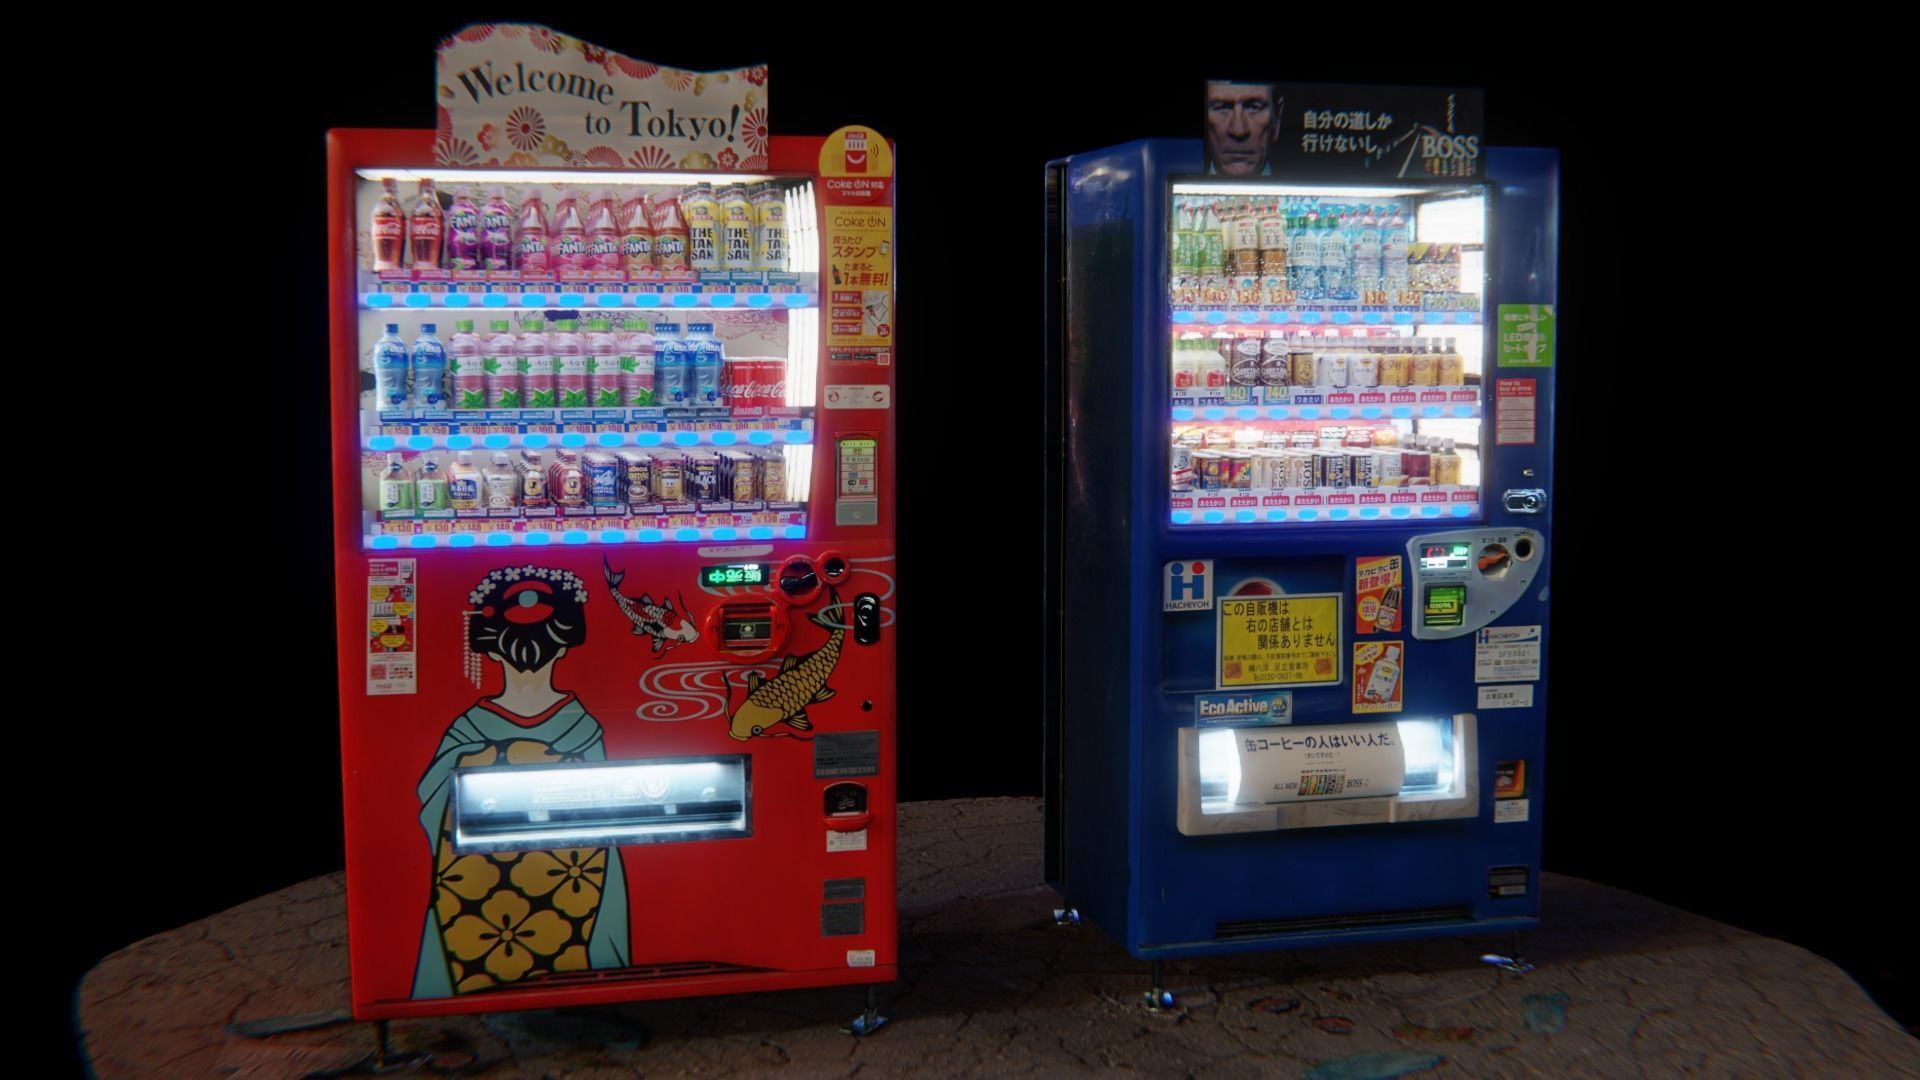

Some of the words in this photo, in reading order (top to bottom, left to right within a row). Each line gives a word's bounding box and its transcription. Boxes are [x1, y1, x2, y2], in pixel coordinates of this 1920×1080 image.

[456, 60, 614, 105] Welcome
[585, 109, 611, 135] to
[619, 100, 740, 143] Tokyo!
[1303, 110, 1392, 130] 自分の道しか
[1421, 135, 1479, 160] BOSS
[827, 179, 852, 189] Coke
[834, 216, 864, 227] Coke
[691, 228, 714, 238] THE
[727, 228, 751, 238] THE
[691, 239, 714, 249] TAN
[727, 239, 751, 249] TAN
[691, 250, 714, 260] SAN
[727, 250, 751, 260] SAN
[832, 246, 878, 258] スタンプ
[1303, 460, 1312, 487] BOS
[1165, 601, 1210, 610] HACHIYOH
[1223, 600, 1289, 616] この自販機は
[1246, 617, 1313, 633] 右の店舗とは
[1257, 633, 1336, 650] 関係ありません
[1244, 732, 1395, 753] 缶コーヒーの人はいい人だ。
